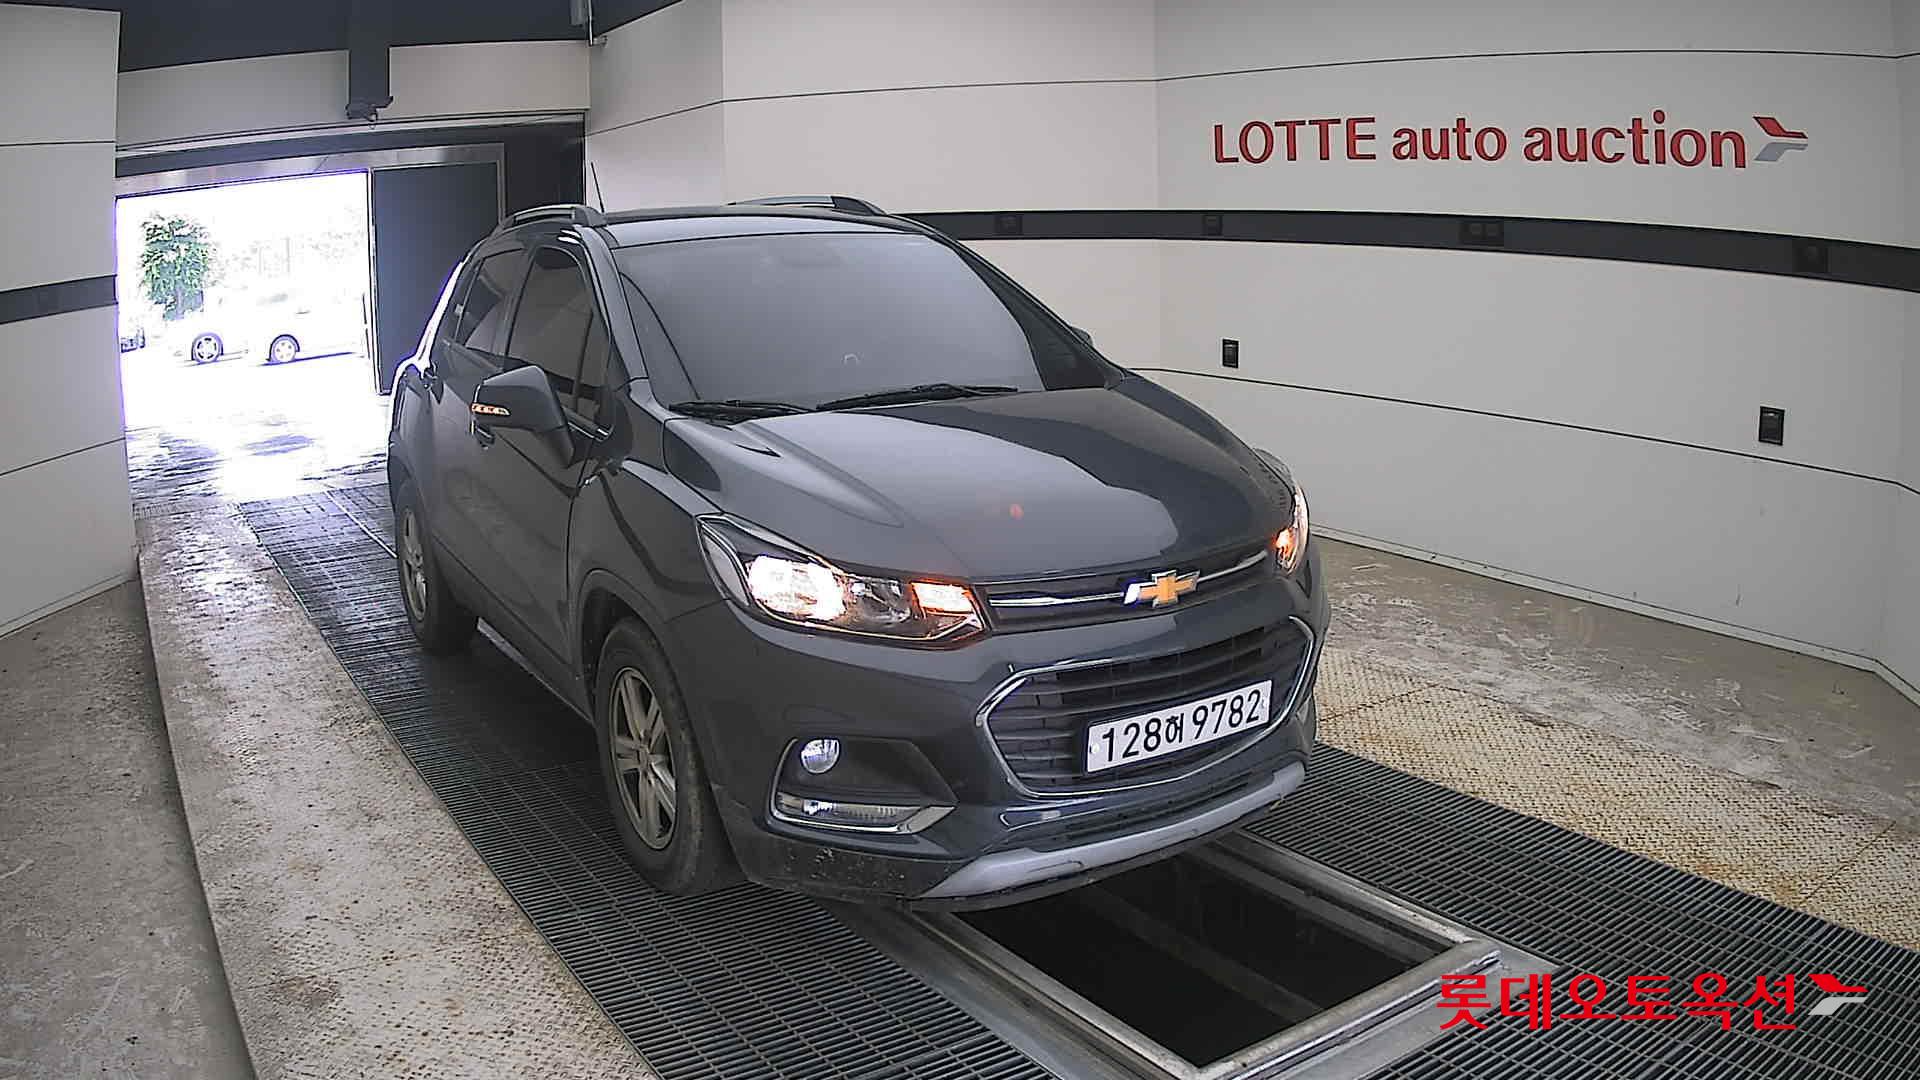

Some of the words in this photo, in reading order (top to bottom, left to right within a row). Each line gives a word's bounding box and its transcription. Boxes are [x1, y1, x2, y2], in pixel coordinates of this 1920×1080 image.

[1213, 116, 1377, 164] LOTTE
[1392, 116, 1508, 162] auto
[1523, 109, 1747, 169] auction
[1102, 712, 1185, 762] 128허
[1192, 689, 1262, 740] 9782
